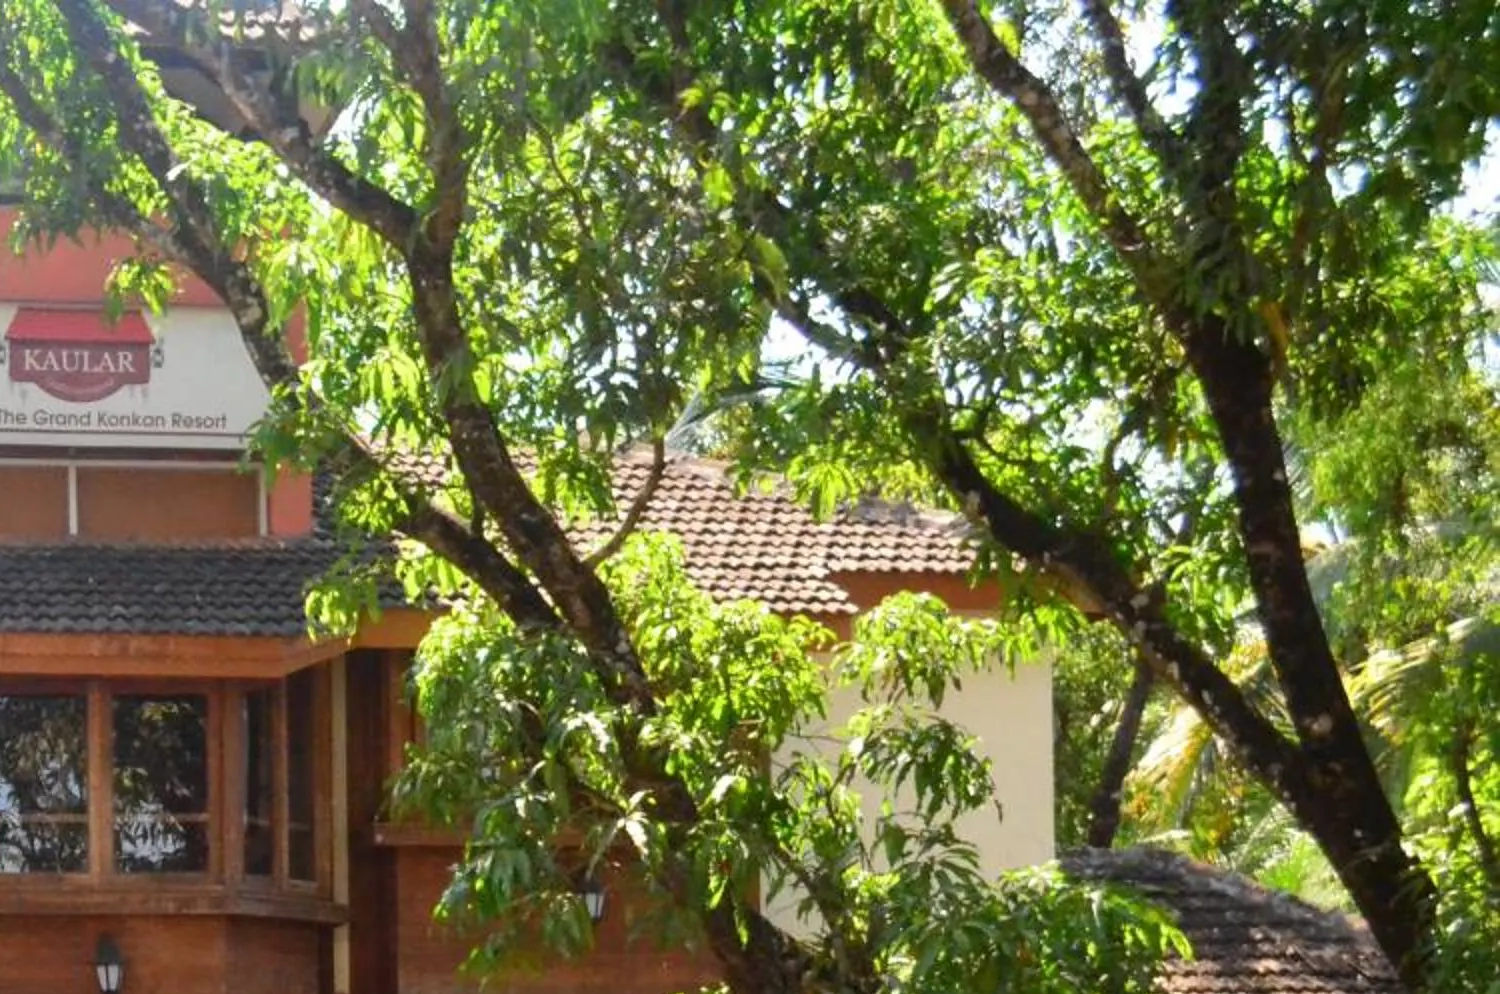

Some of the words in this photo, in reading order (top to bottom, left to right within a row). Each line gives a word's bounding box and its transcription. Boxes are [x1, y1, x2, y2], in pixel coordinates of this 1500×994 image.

[23, 349, 136, 373] KAULAR
[33, 409, 91, 426] Grand
[171, 412, 227, 429] Resort
